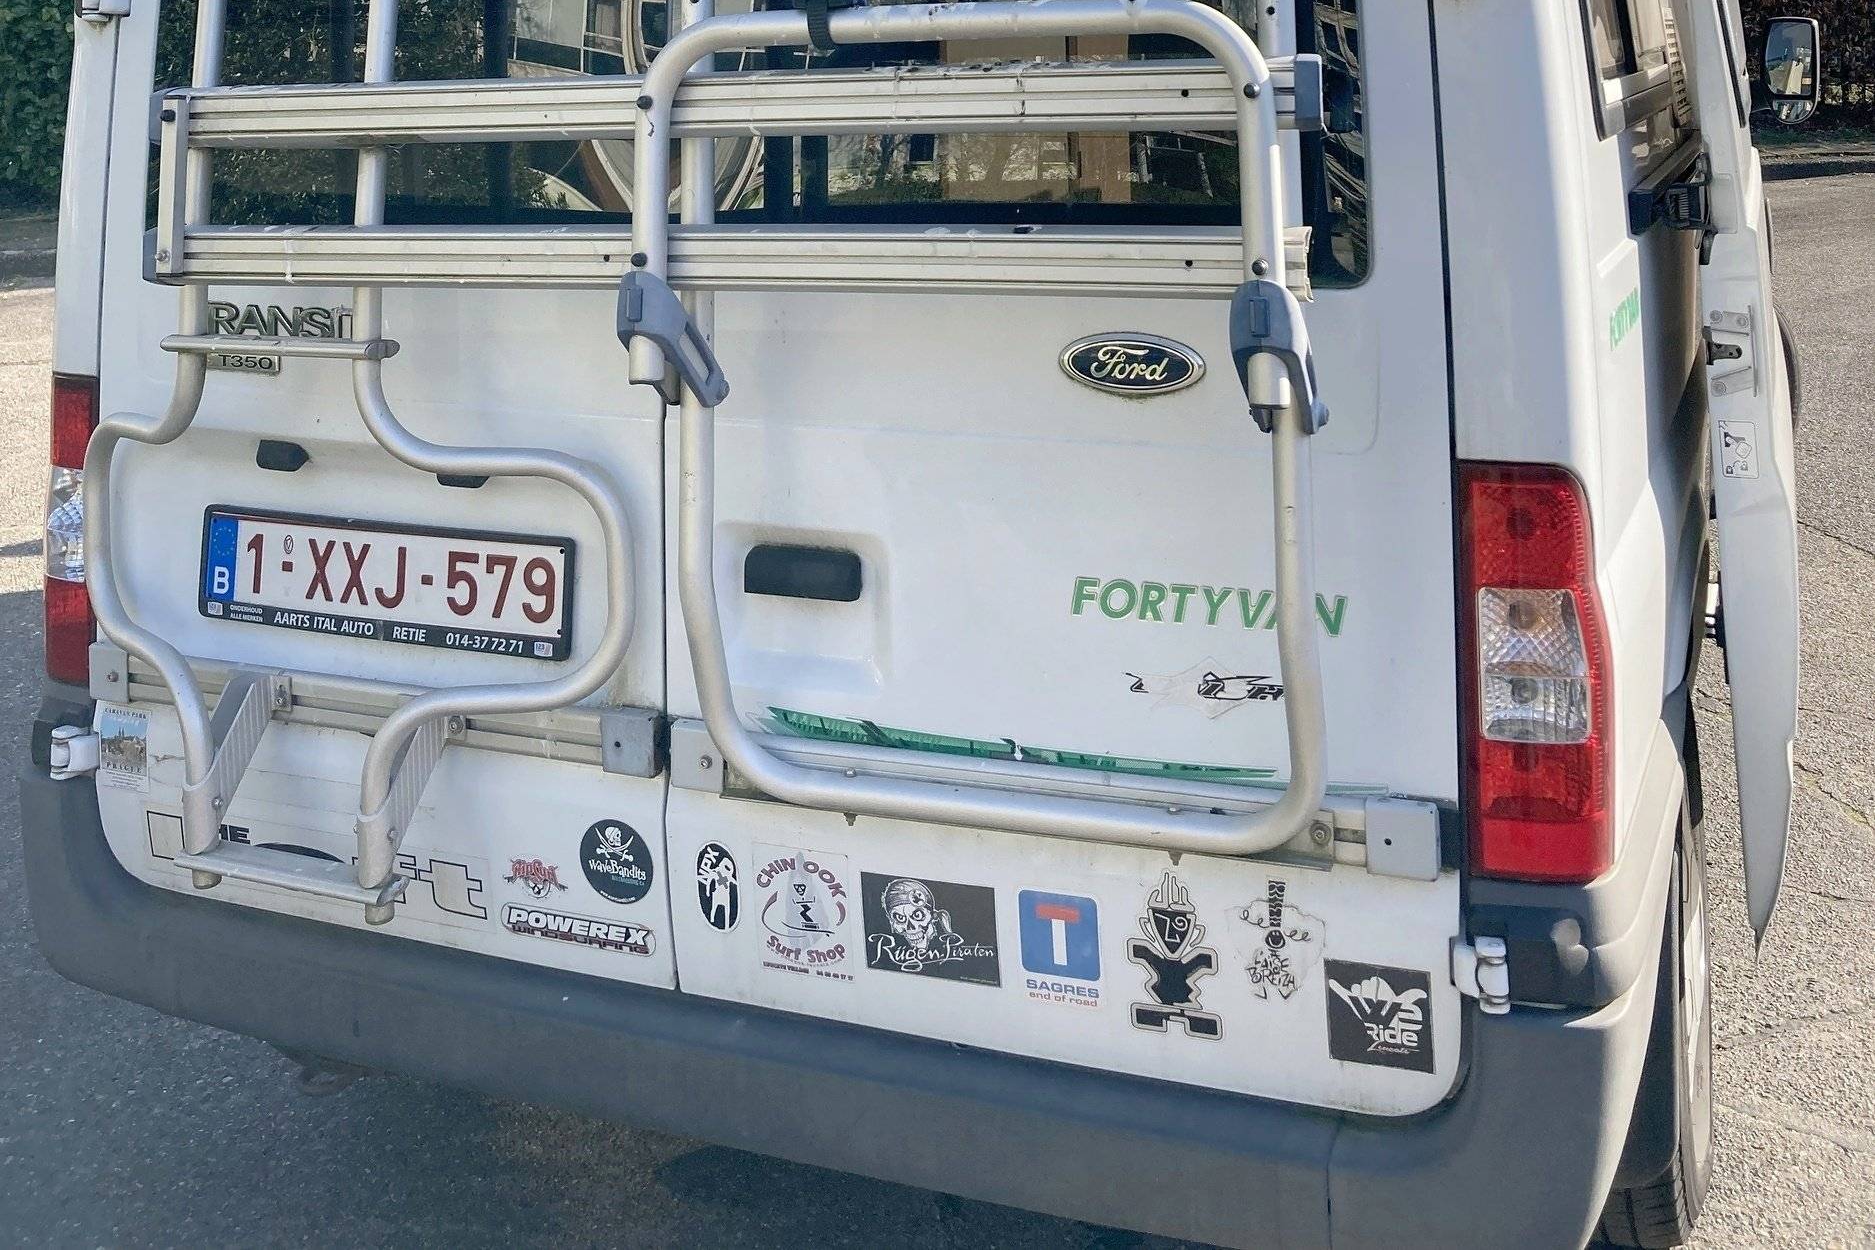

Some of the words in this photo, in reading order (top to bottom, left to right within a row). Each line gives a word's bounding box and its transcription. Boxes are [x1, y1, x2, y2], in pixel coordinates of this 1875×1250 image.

[218, 354, 273, 370] T350
[1089, 345, 1169, 382] Ford
[212, 566, 230, 595] B
[246, 533, 557, 624] 1-XXJ-579
[1070, 576, 1348, 638] FORTYVN
[274, 611, 310, 628] AARTS
[313, 615, 338, 632] ITAL
[340, 618, 374, 636] AUTO
[393, 626, 426, 643] RETIE
[445, 632, 490, 649] 014-37
[490, 636, 506, 652] 72
[508, 639, 524, 654] 71
[588, 858, 647, 881] WaveBandits
[508, 907, 650, 945] POWEREX
[766, 935, 802, 960] Surf
[807, 943, 845, 963] Shop
[1026, 978, 1100, 999] SAGRES
[1029, 990, 1051, 1001] end
[1054, 994, 1067, 1003] of
[1069, 996, 1098, 1007] road
[1364, 1022, 1418, 1046] Ride
